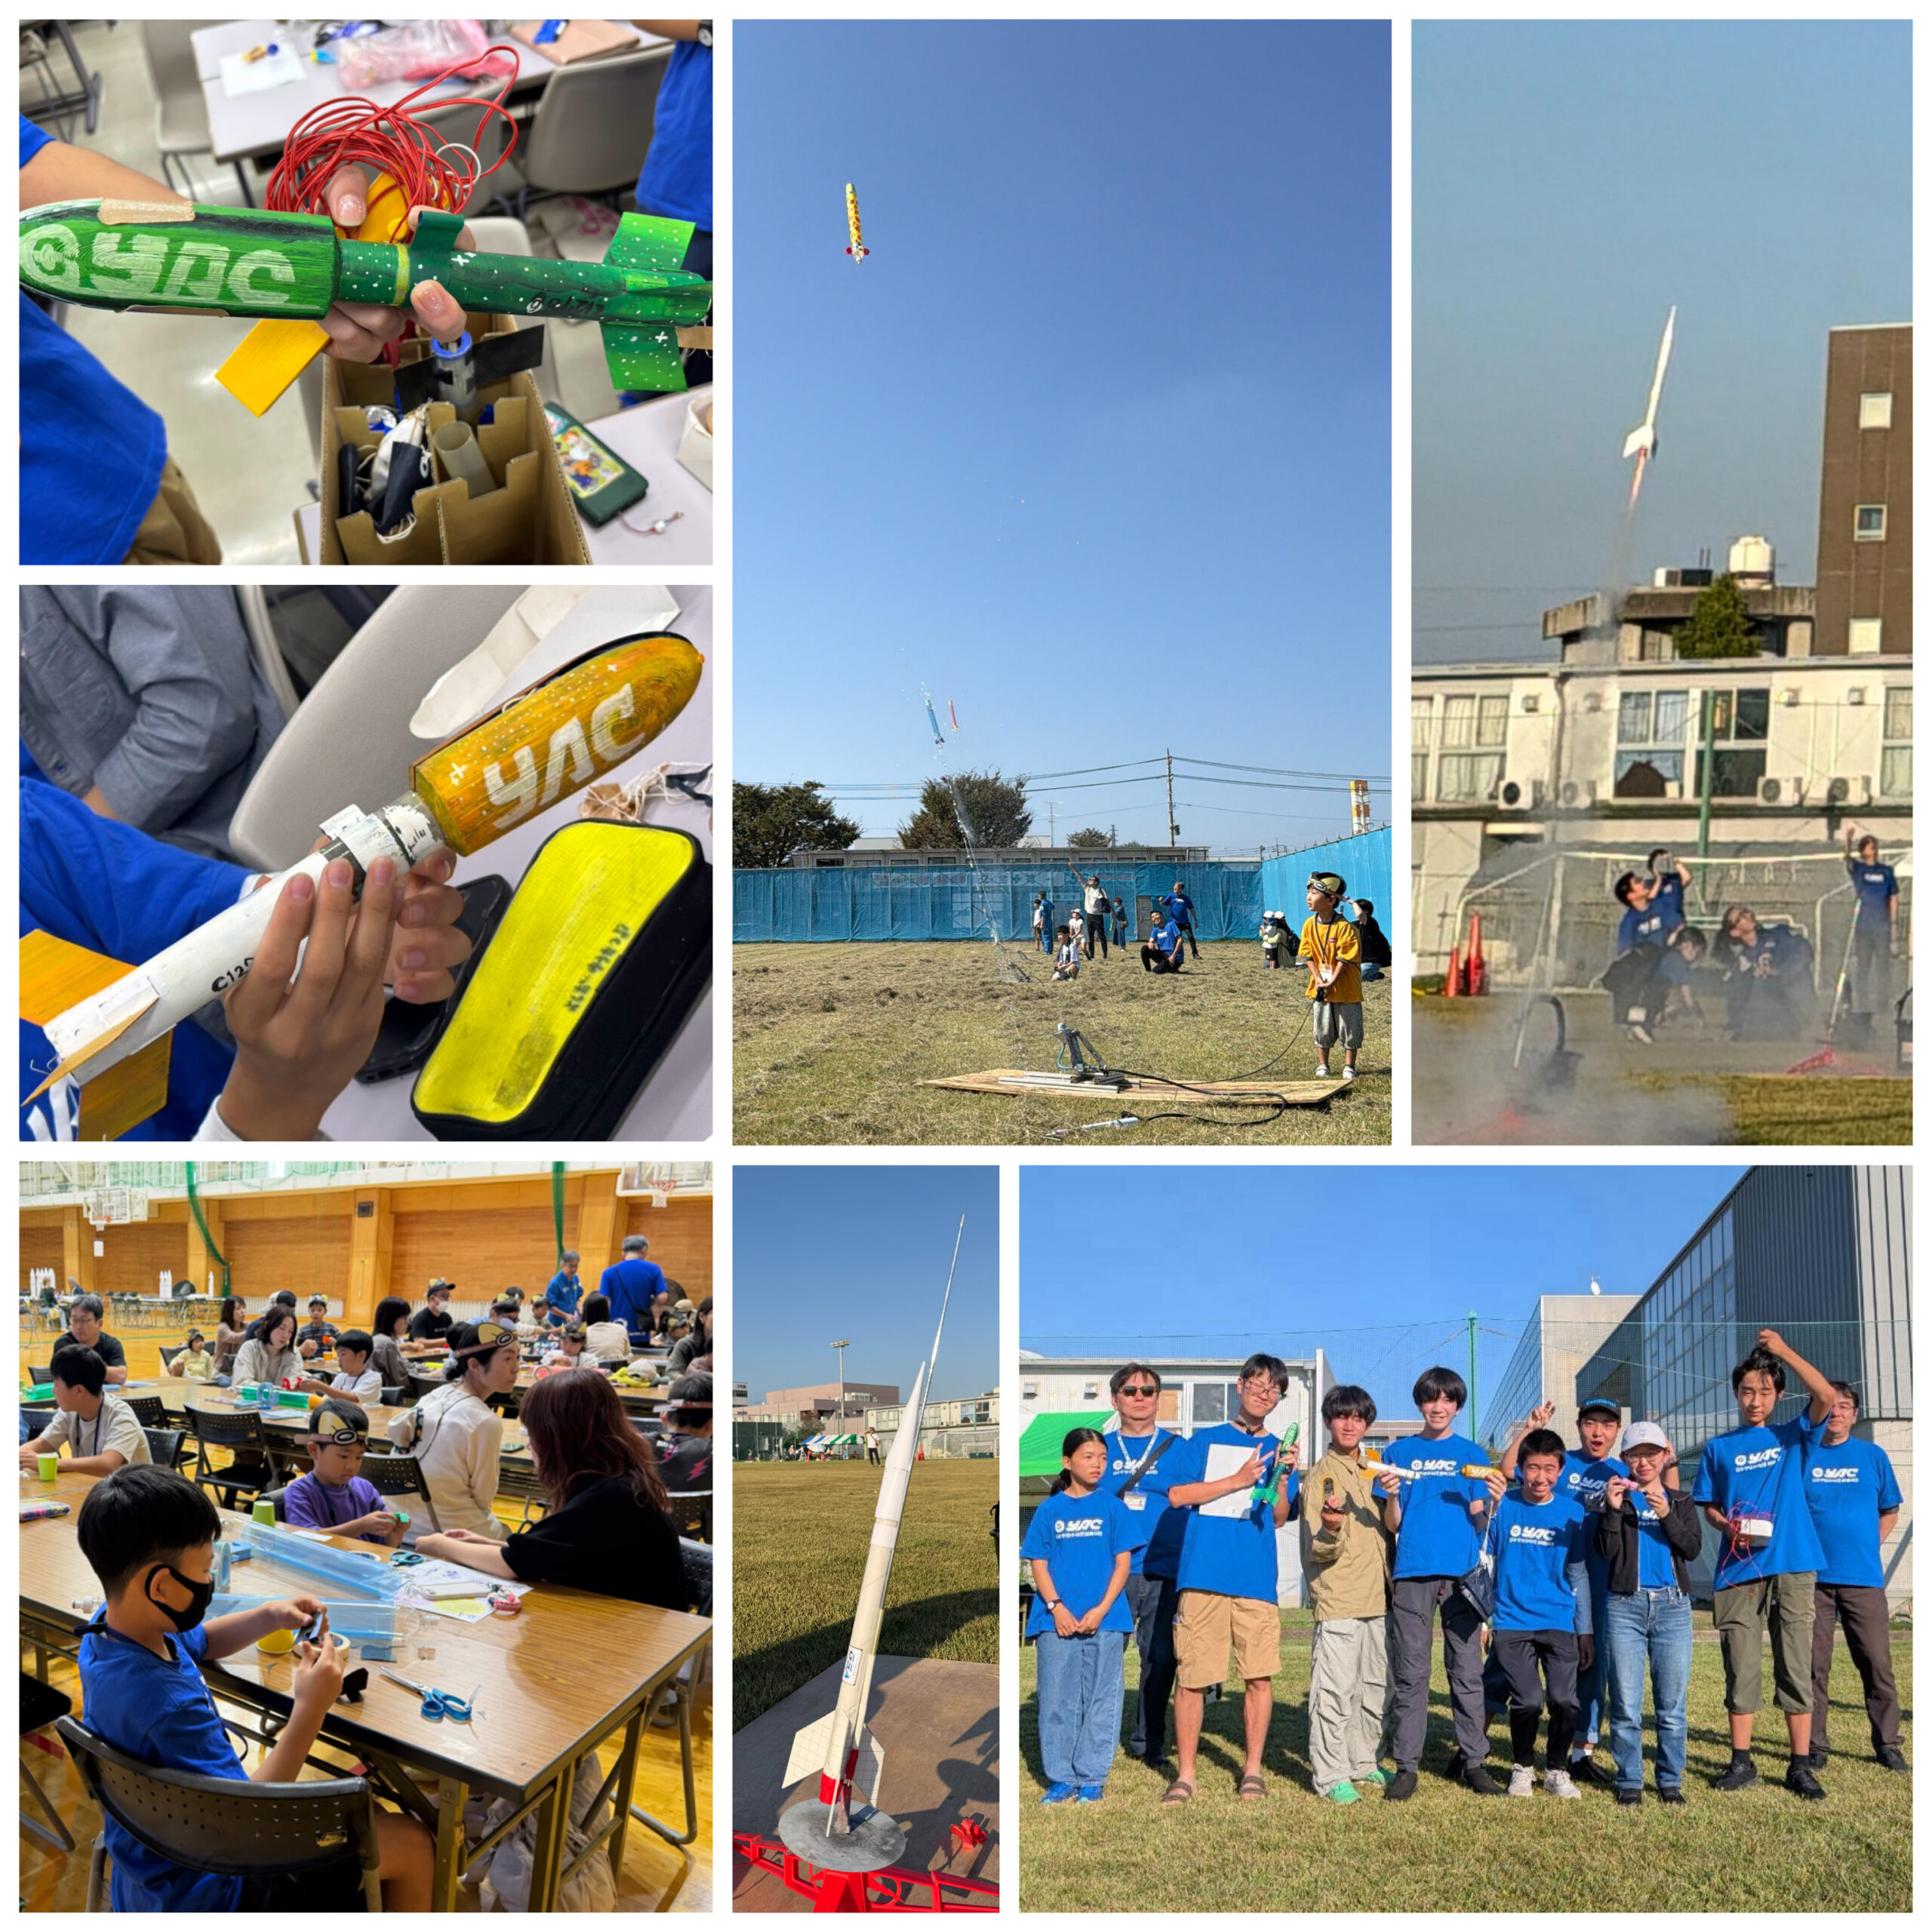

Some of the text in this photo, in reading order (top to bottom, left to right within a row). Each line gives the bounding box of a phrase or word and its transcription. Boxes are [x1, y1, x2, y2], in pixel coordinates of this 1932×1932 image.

[483, 682, 645, 829] YAC
[1747, 1447, 1782, 1464] YAC
[1423, 1460, 1457, 1470] YAC
[1824, 1468, 1859, 1478] YAC
[1066, 1518, 1103, 1532] YAC
[1521, 1525, 1556, 1541] YAC
